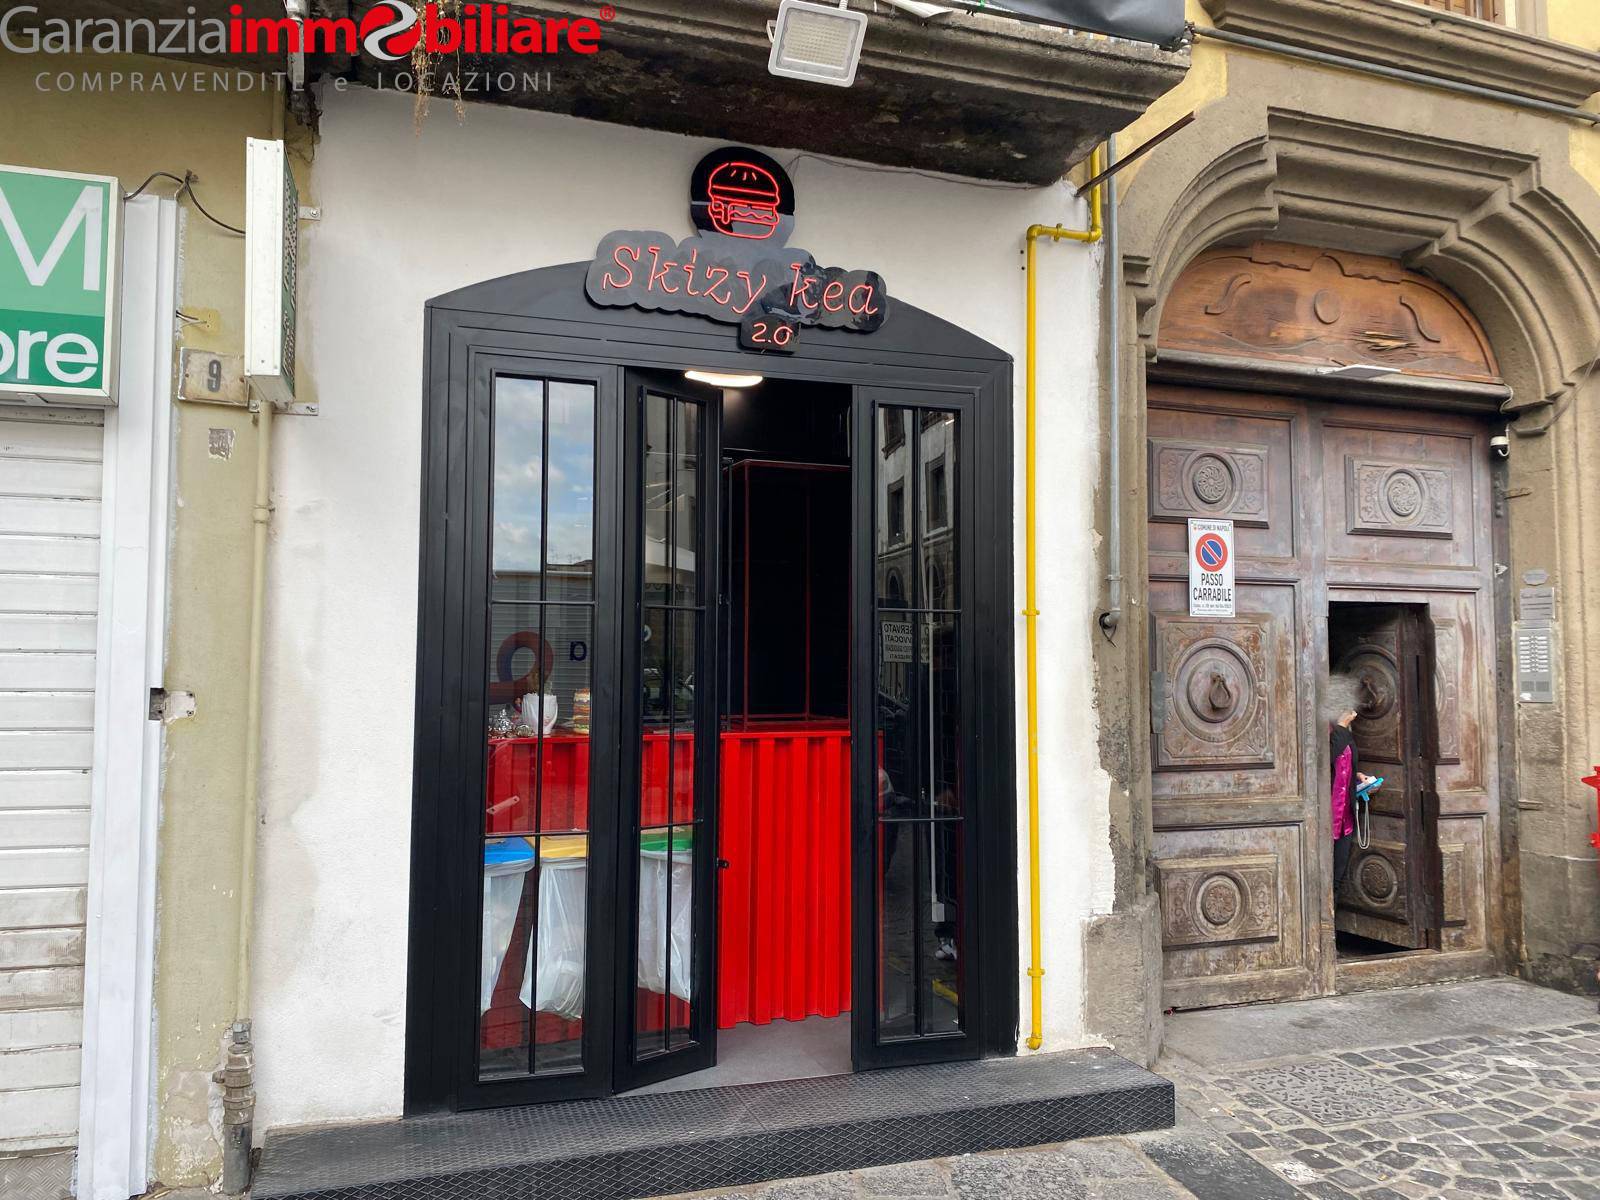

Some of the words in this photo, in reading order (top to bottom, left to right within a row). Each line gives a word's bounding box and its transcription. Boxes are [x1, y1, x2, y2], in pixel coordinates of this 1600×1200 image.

[602, 245, 767, 314] Skizy
[789, 263, 879, 316] kea
[750, 321, 794, 346] 2.0
[207, 359, 222, 393] 9
[1201, 573, 1223, 586] PASSO
[1193, 587, 1232, 602] CARRABILE
